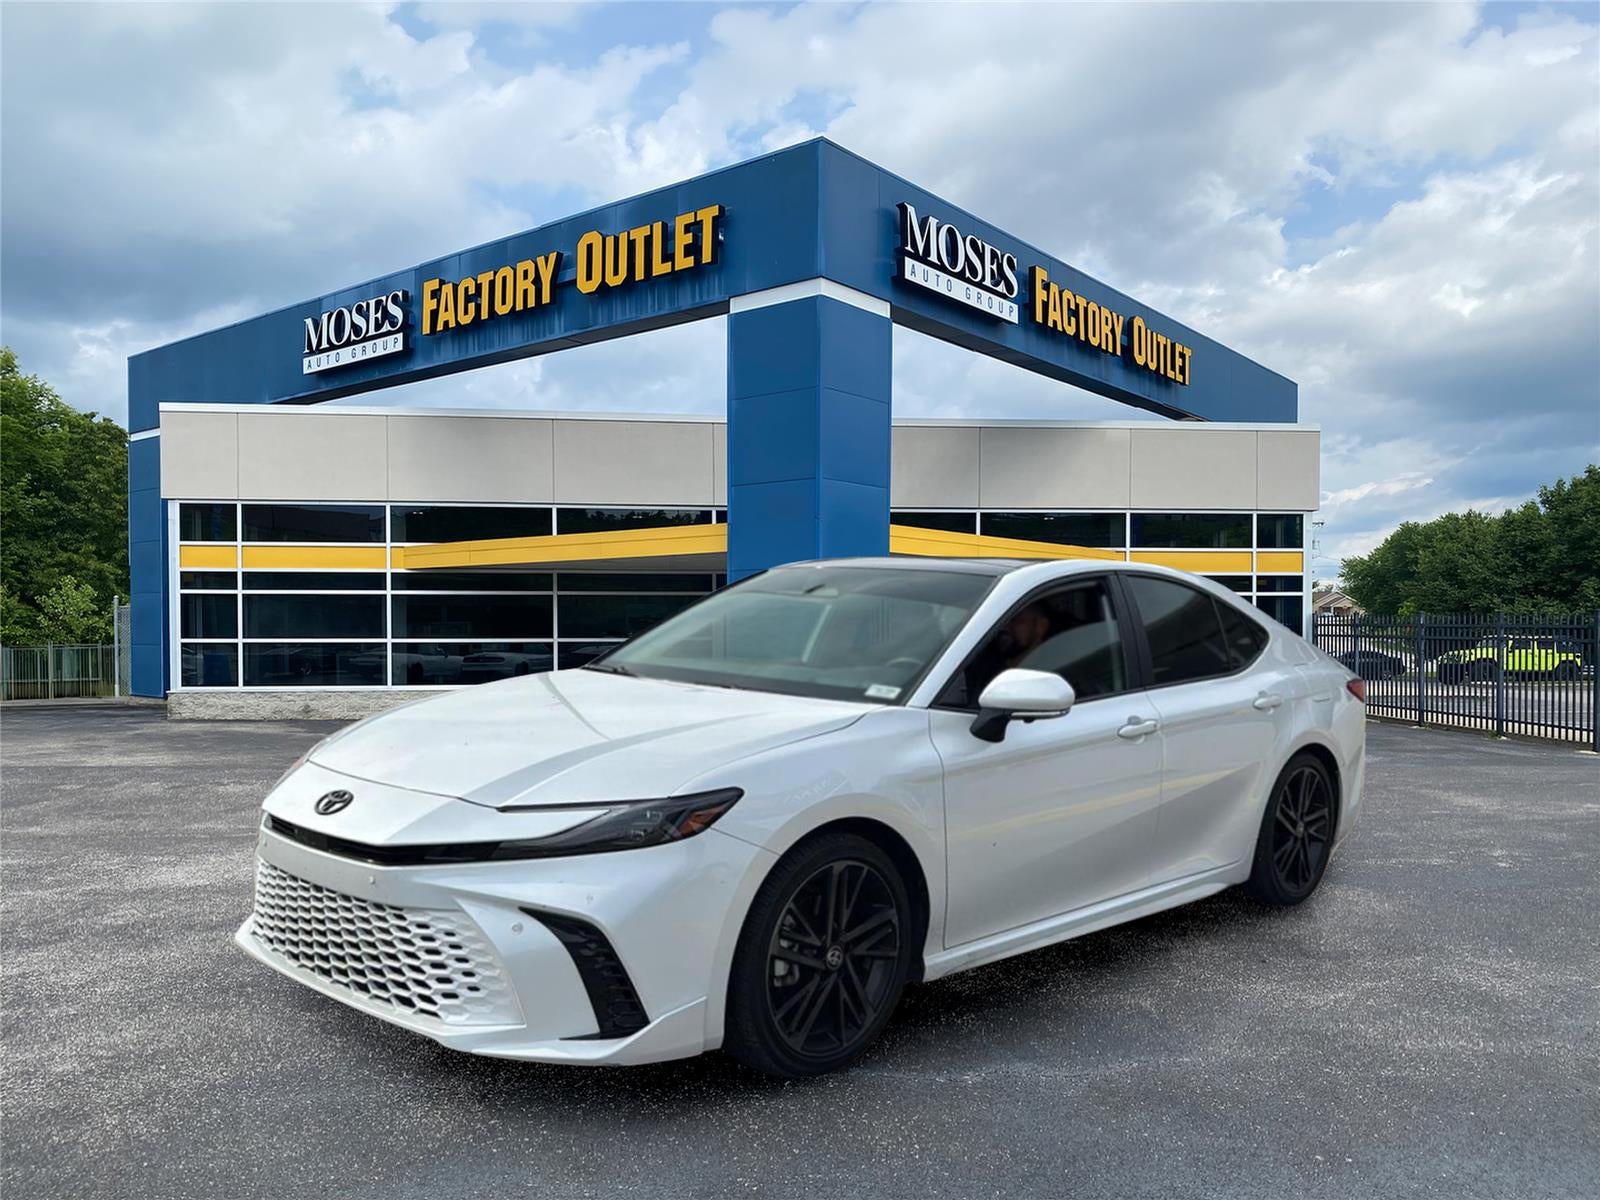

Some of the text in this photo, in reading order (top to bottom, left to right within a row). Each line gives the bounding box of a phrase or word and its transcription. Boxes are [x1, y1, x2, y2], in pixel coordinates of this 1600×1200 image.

[422, 204, 720, 336] FACTORY OUTLET
[904, 202, 1019, 299] MOSES
[910, 263, 1015, 318] AUTO GROUP
[303, 289, 404, 354] MOSES
[306, 337, 400, 370] AUTO GROUP
[1034, 266, 1192, 385] FACTORY OUTLET
